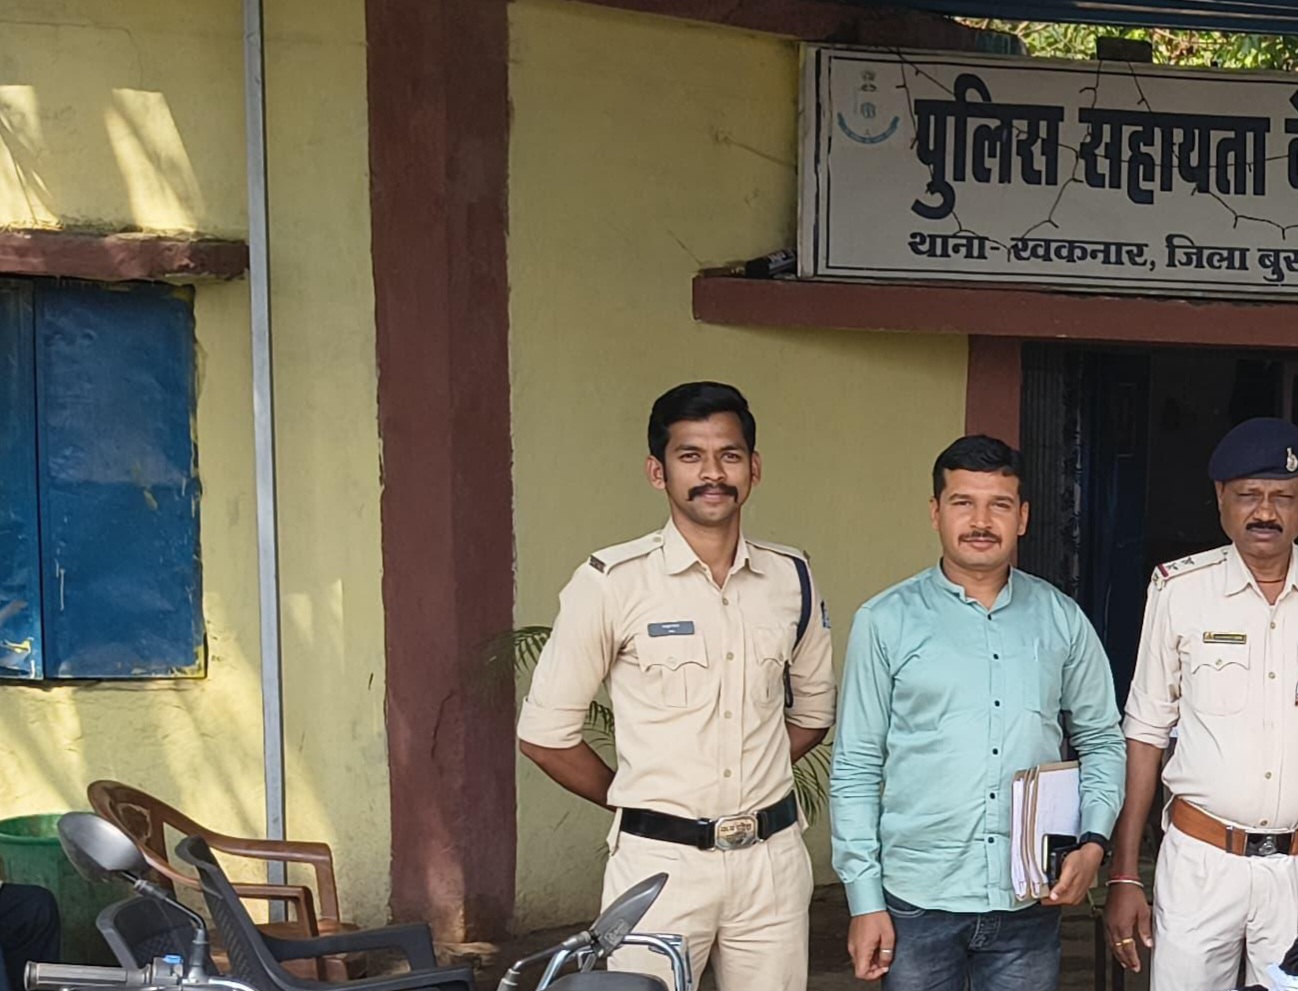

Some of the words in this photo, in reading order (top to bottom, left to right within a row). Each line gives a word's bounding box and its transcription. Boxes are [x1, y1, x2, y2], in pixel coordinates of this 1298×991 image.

[911, 73, 1064, 219] पुलिस
[1078, 107, 1270, 204] सहायता
[1011, 237, 1156, 271] खकनार,
[1165, 234, 1249, 270] जिला
